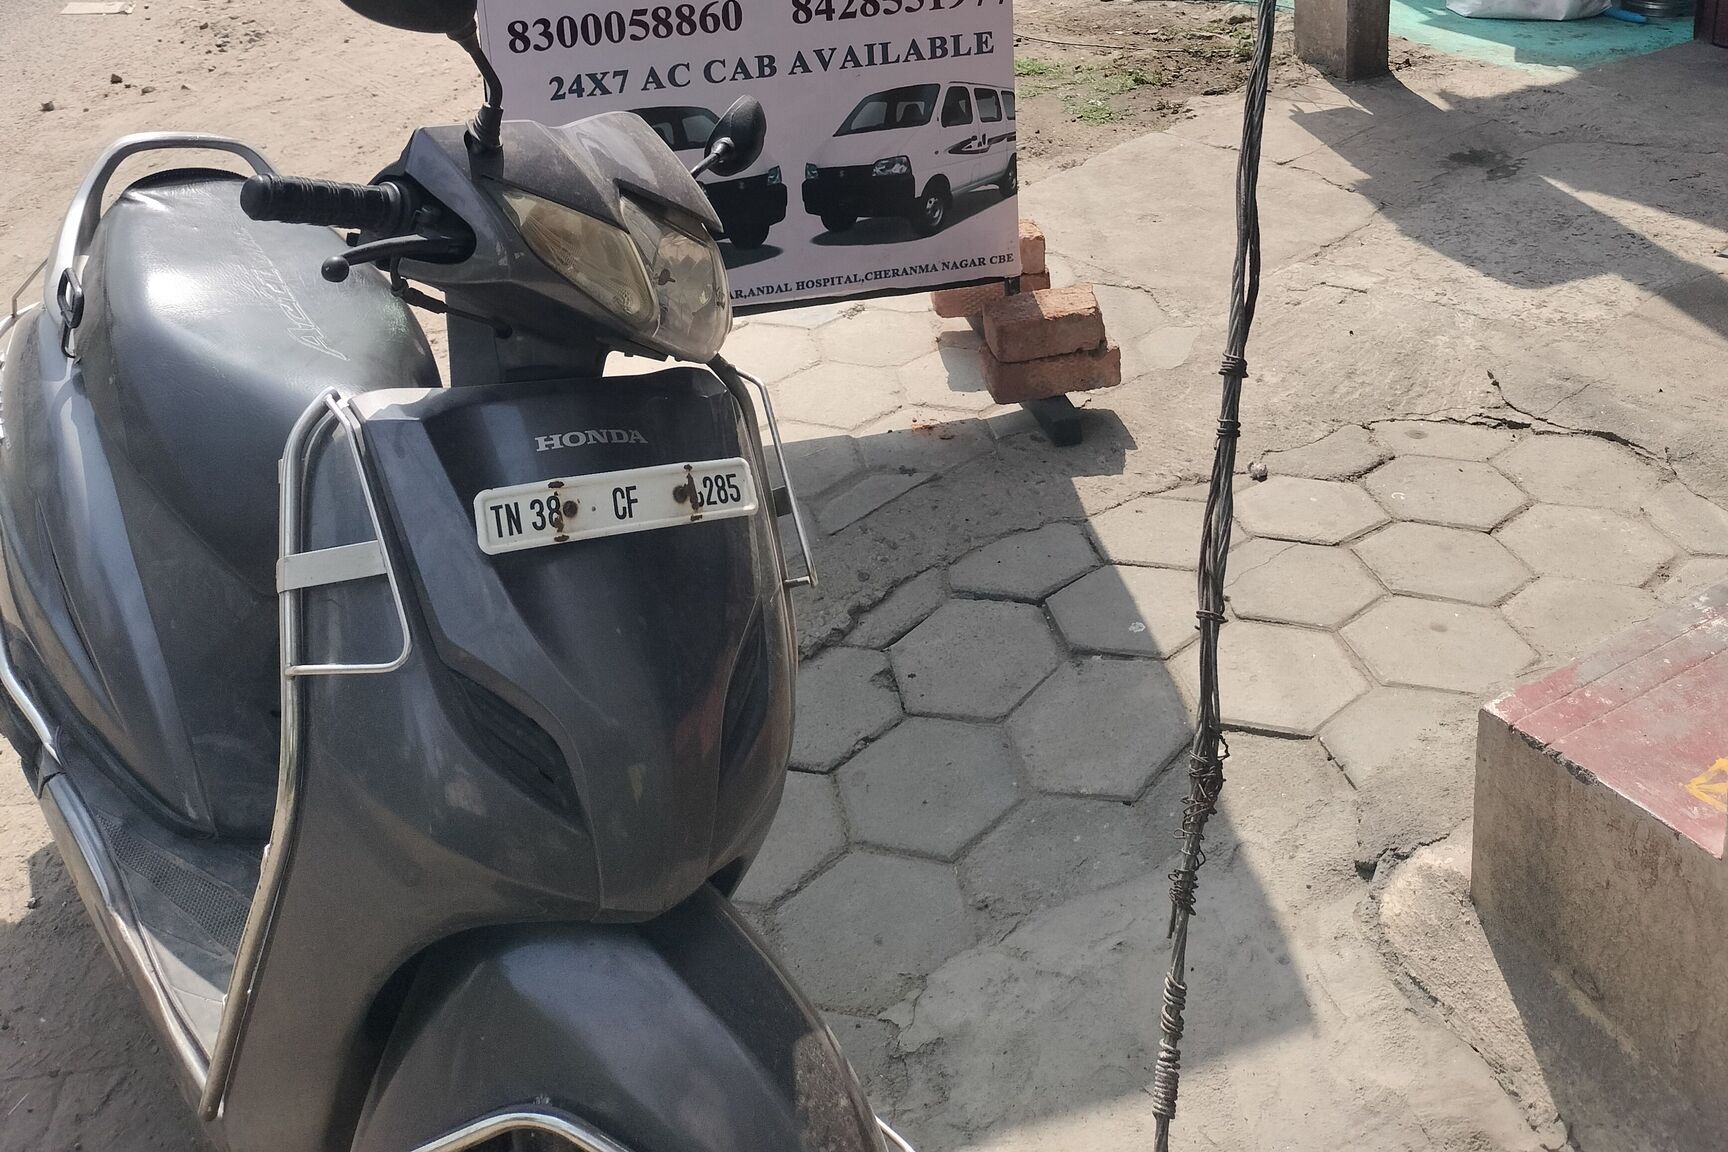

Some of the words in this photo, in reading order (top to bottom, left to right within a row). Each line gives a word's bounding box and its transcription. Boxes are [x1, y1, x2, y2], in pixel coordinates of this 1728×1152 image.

[507, 0, 743, 54] 8300058860
[549, 69, 630, 102] 24X7
[641, 62, 691, 92] AC
[703, 55, 777, 84] CAB
[788, 31, 995, 76] AVAILABLE
[941, 257, 987, 271] NAGAR
[989, 252, 1014, 265] CBE
[535, 429, 648, 452] HONDA
[490, 502, 522, 538] TN
[529, 495, 562, 531] 38
[612, 486, 638, 520] CF
